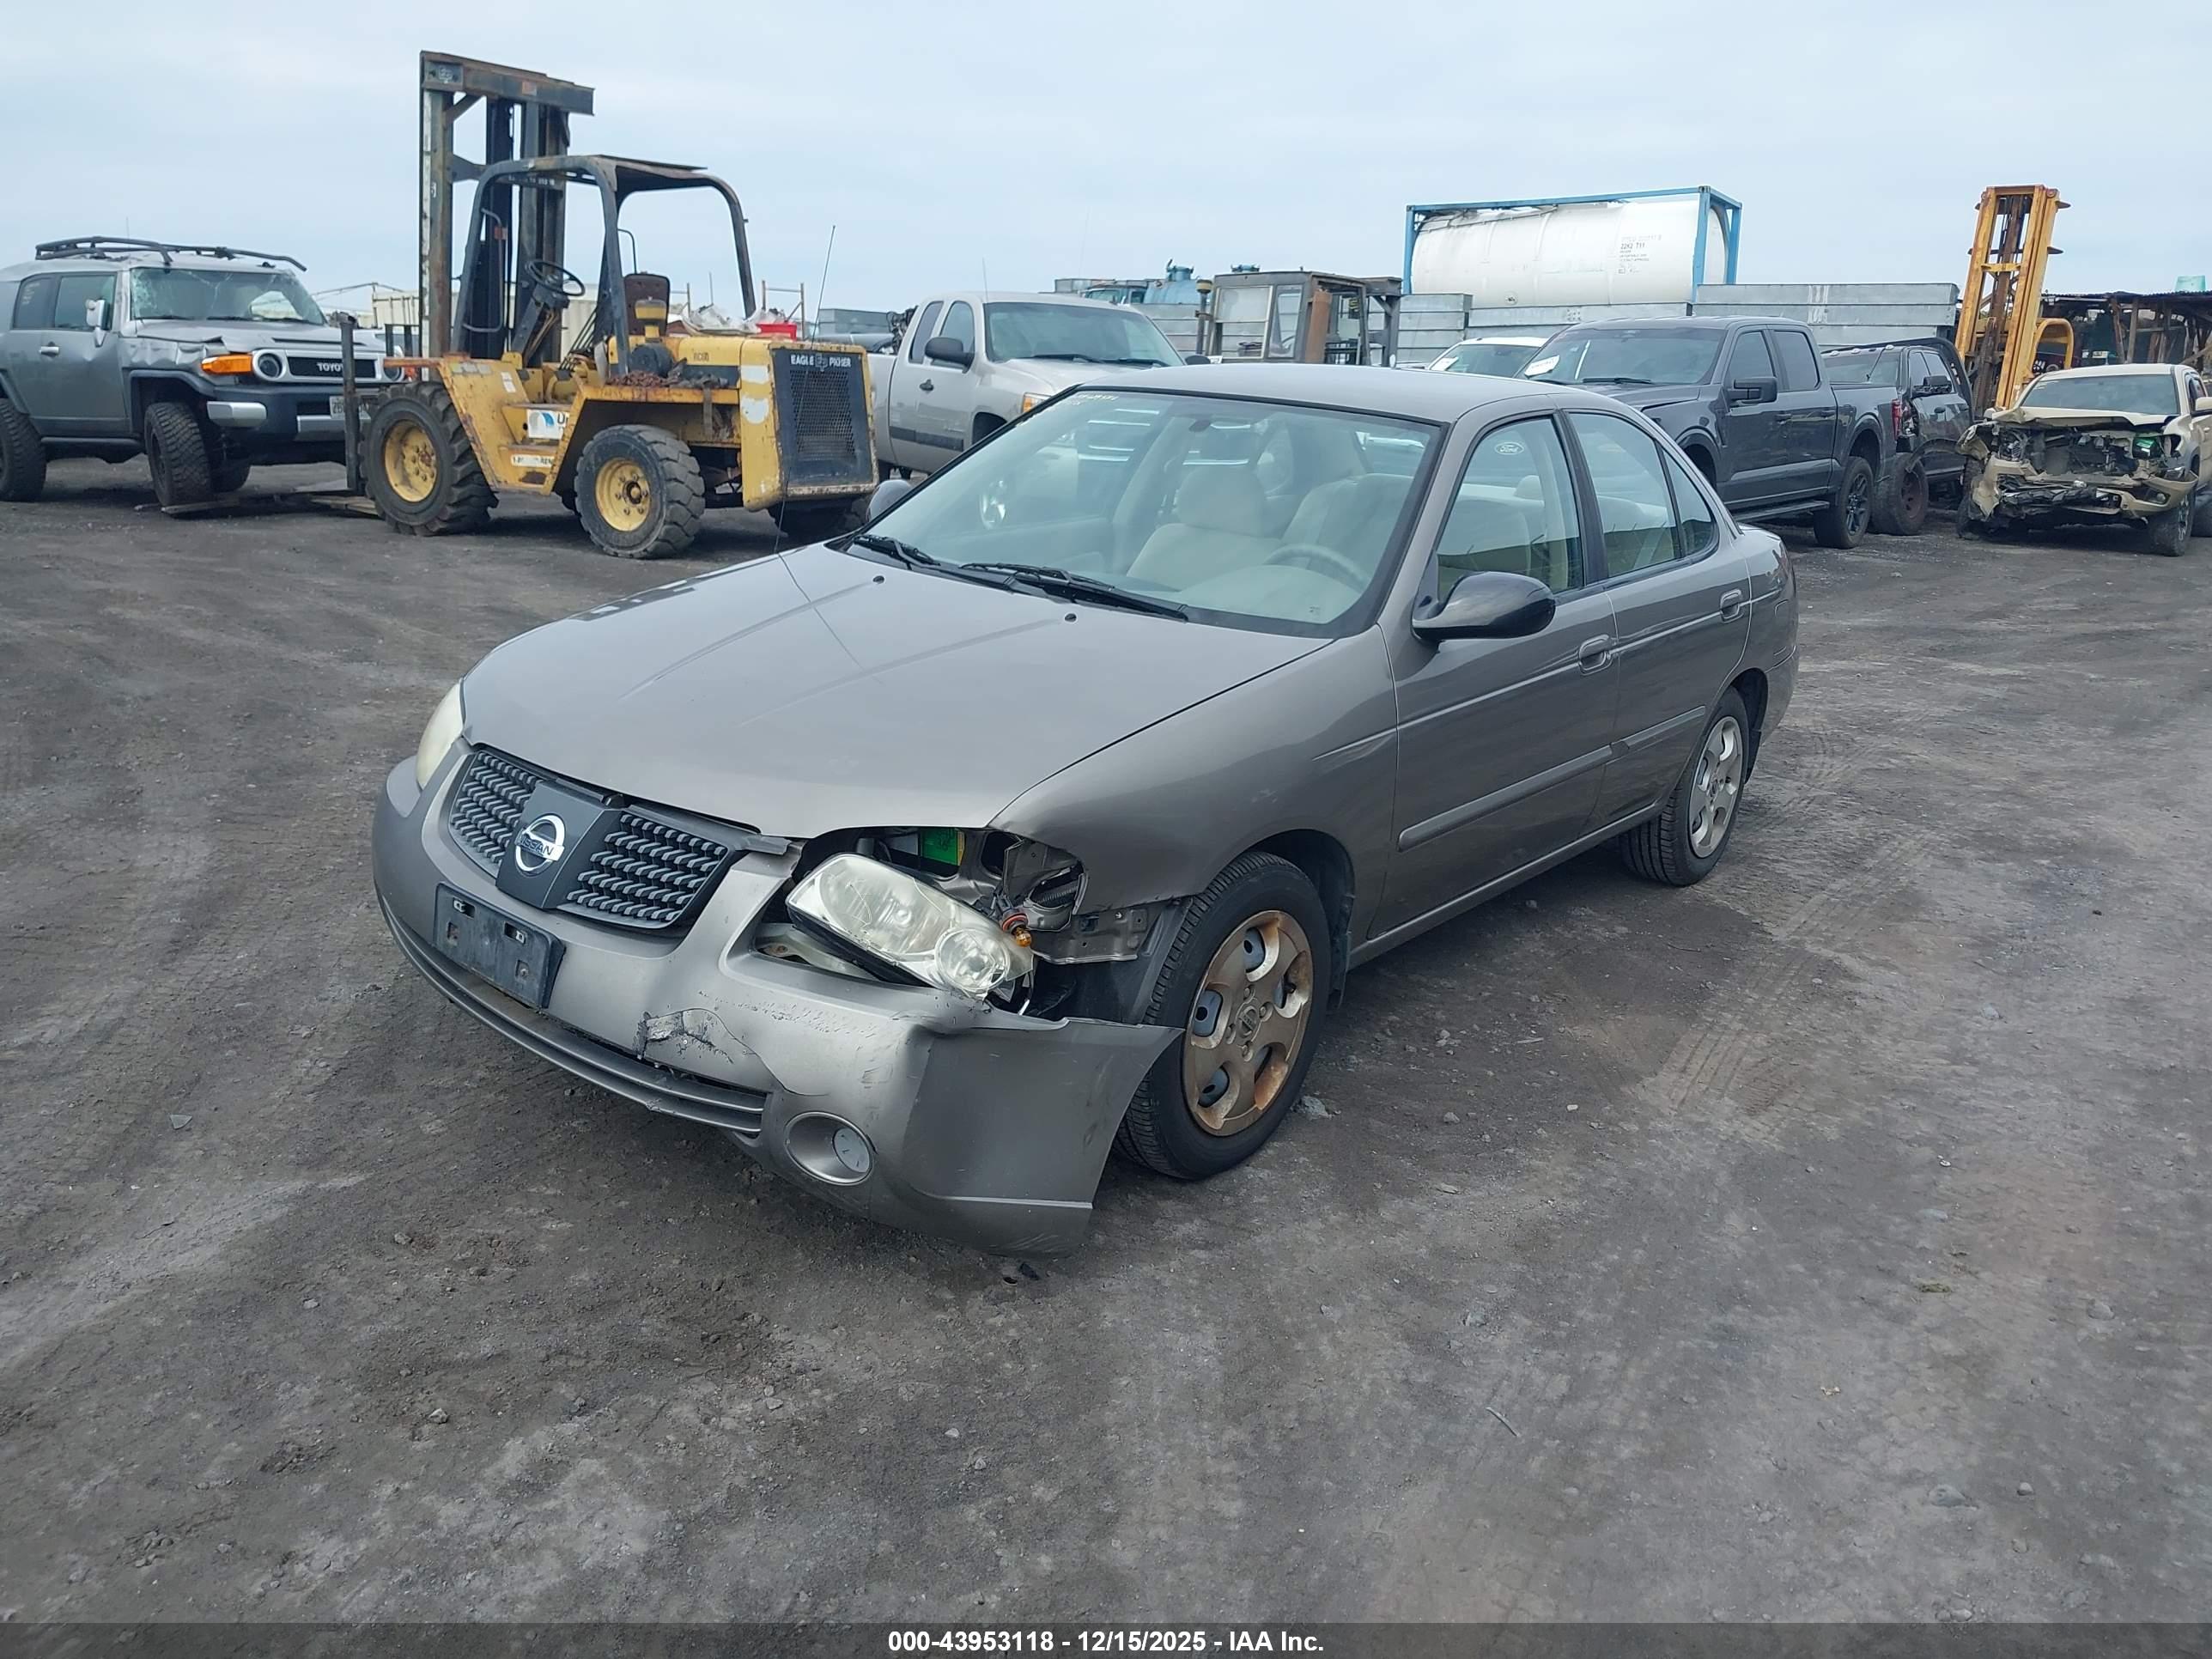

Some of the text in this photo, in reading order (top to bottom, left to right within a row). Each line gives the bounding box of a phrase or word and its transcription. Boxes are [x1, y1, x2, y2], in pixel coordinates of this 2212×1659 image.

[790, 354, 815, 367] EAGLE
[317, 362, 343, 372] TOYO
[1497, 443, 1521, 453] Ford
[519, 833, 555, 856] NISSAN
